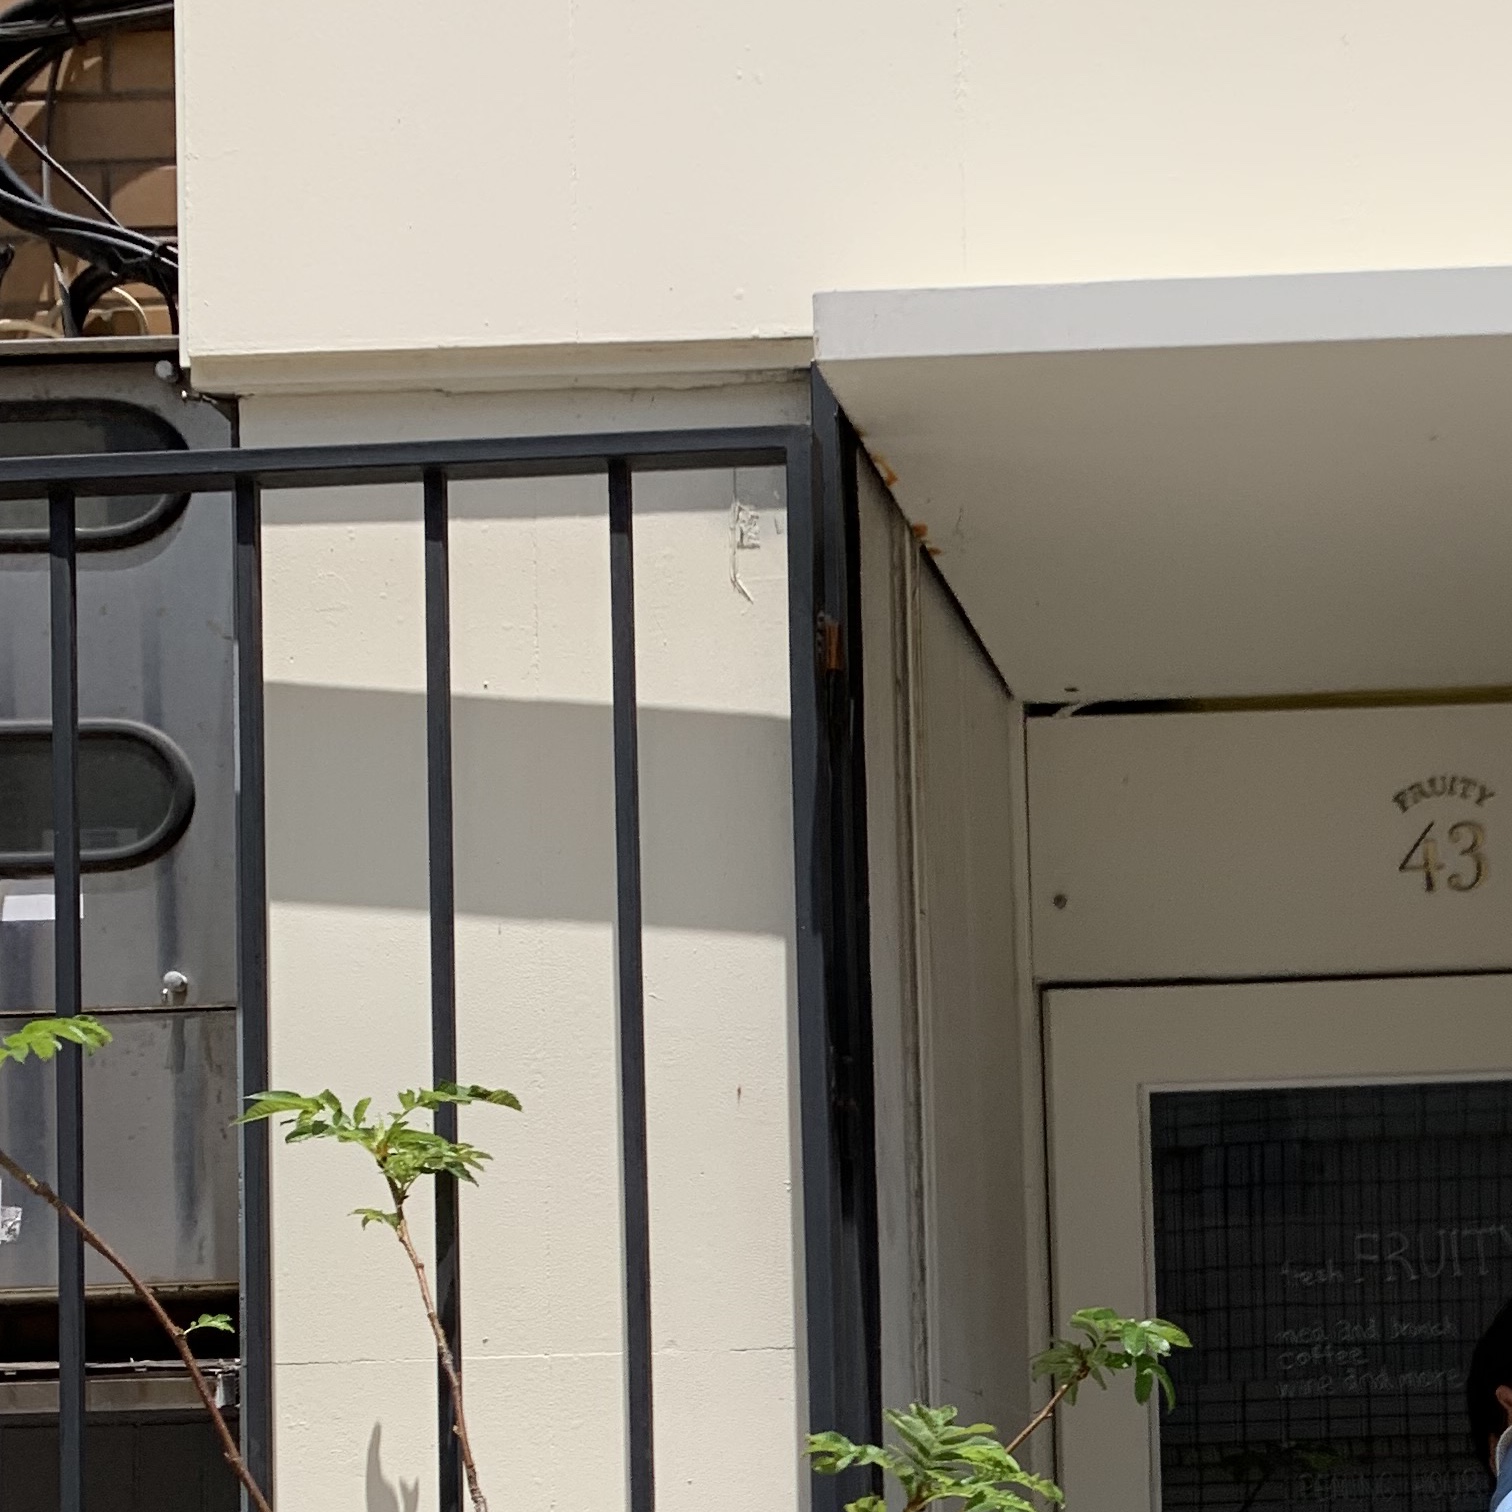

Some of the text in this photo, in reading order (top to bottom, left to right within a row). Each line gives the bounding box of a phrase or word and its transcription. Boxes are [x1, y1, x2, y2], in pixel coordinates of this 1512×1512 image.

[1391, 776, 1496, 813] FRUITY
[1399, 820, 1489, 892] 43
[1276, 1342, 1369, 1371] coffee
